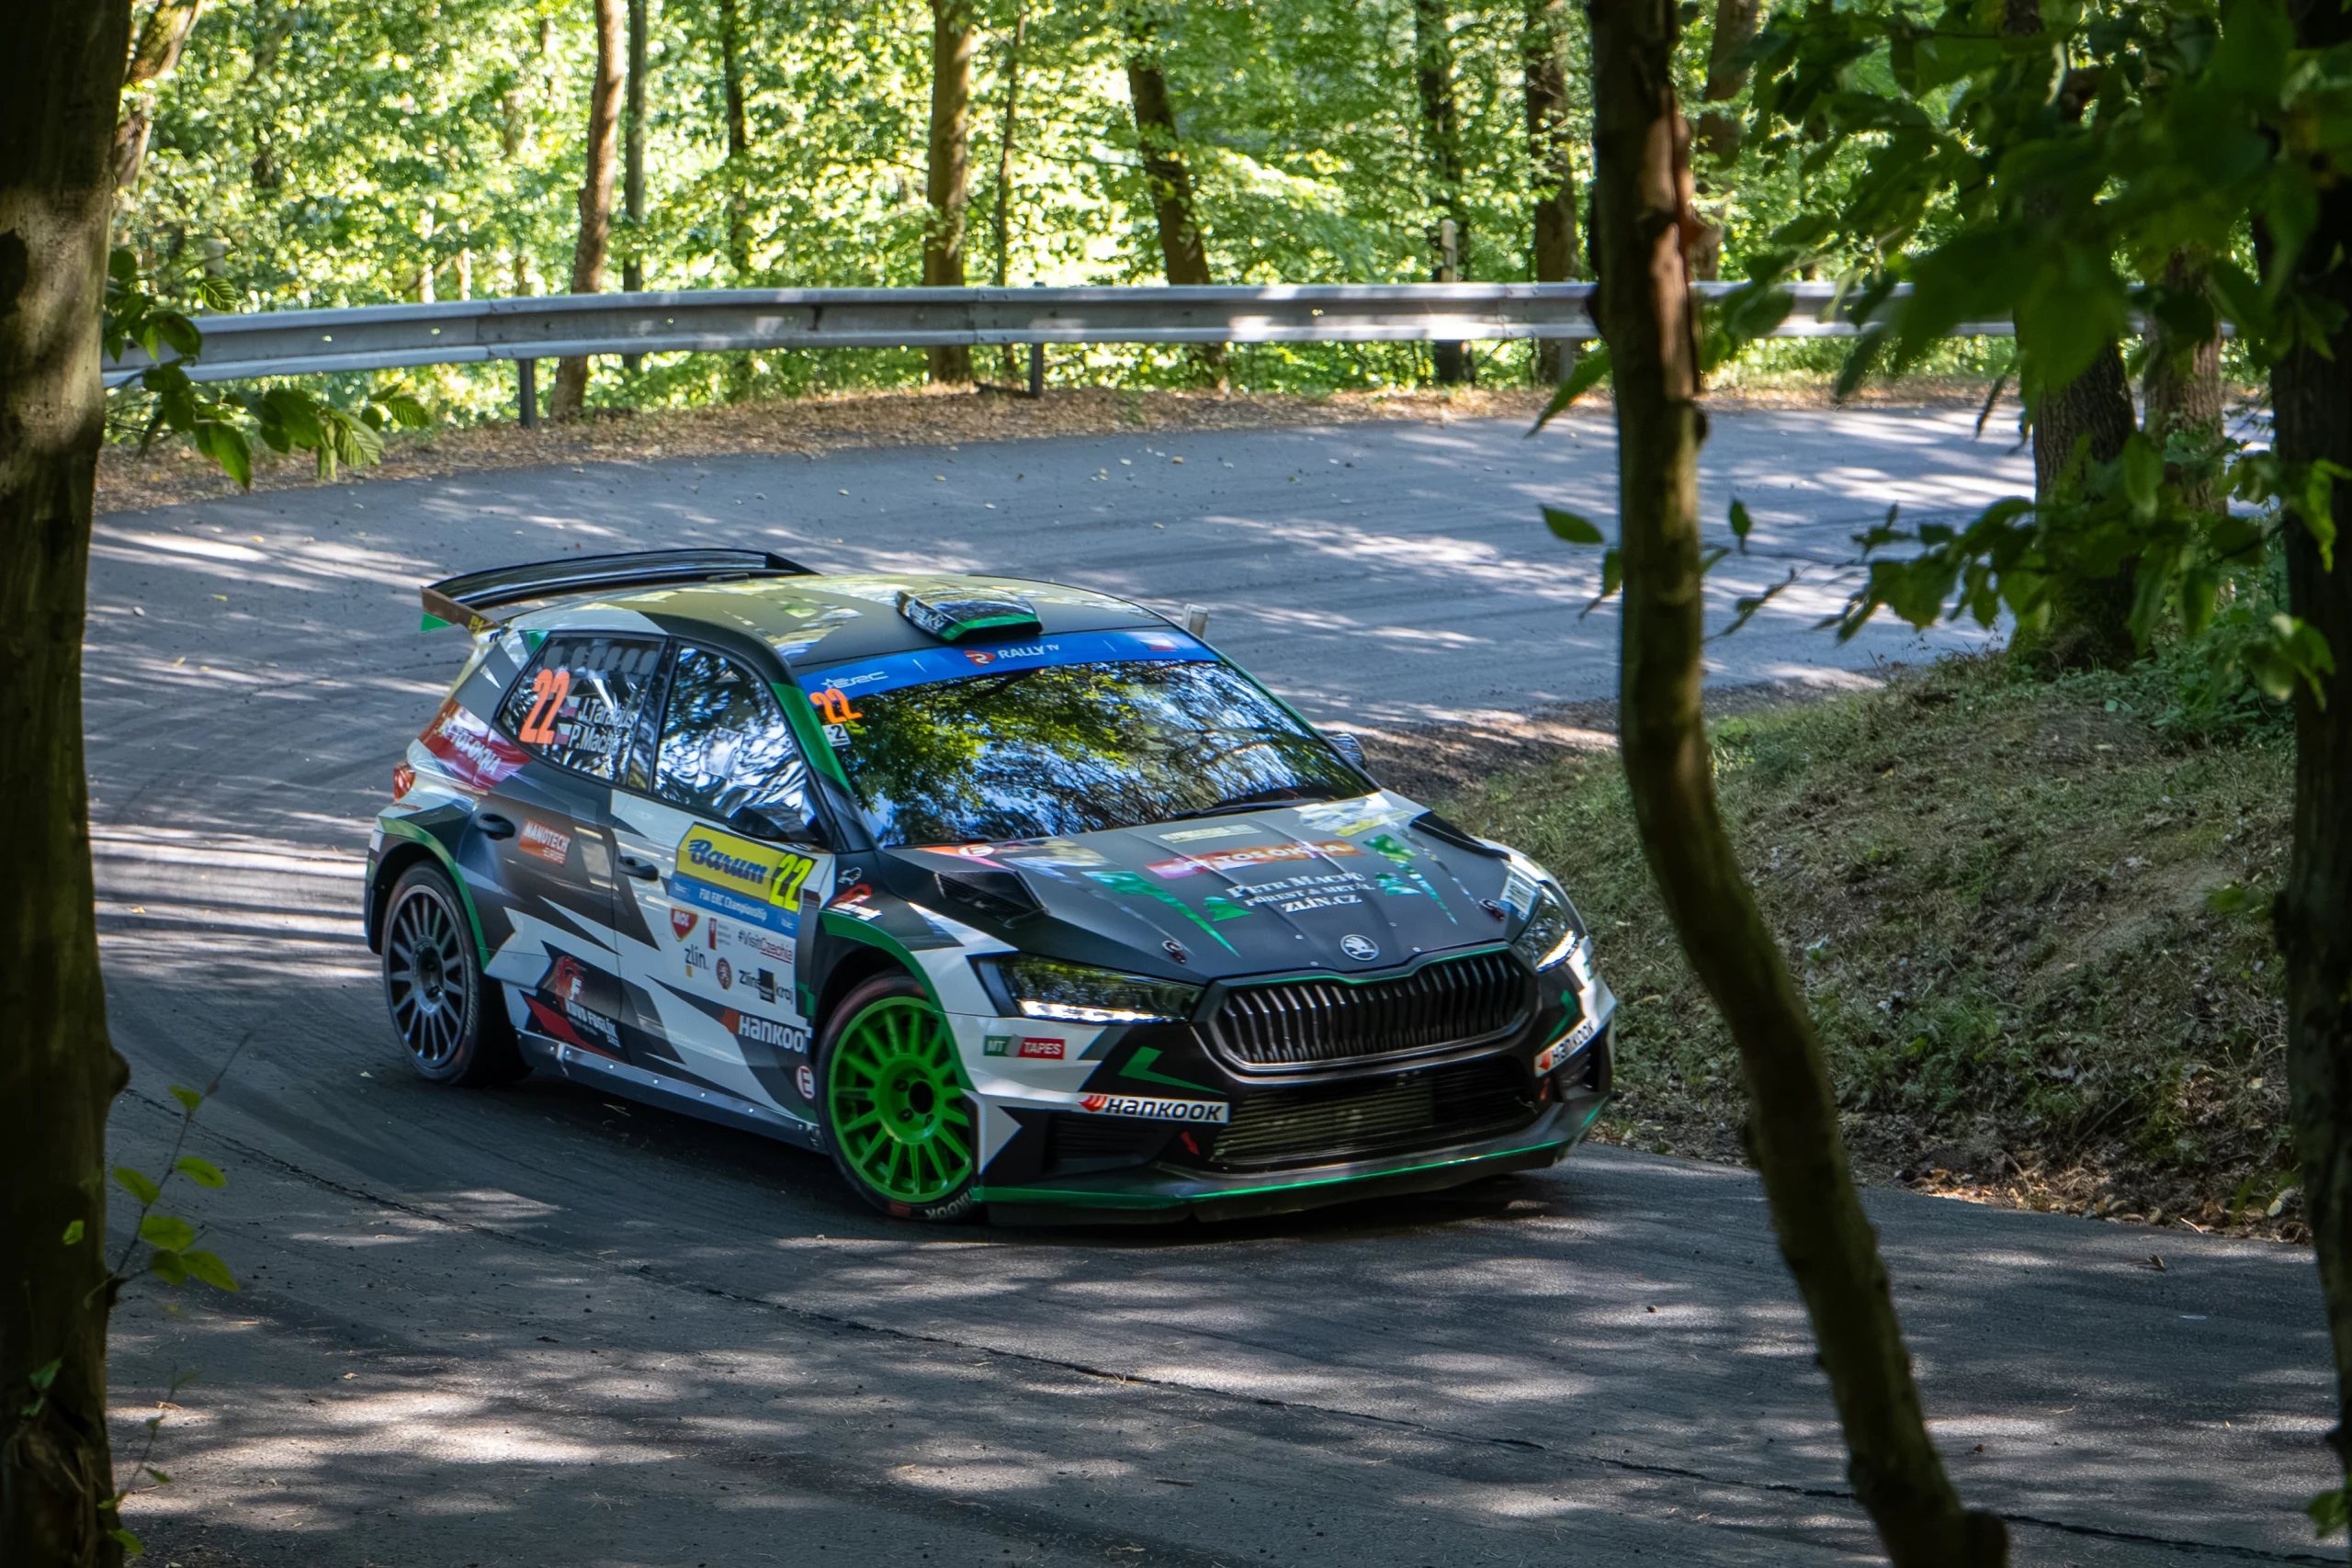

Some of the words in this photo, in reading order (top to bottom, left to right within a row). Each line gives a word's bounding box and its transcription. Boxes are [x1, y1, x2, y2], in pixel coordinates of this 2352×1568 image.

[998, 646, 1046, 659] RALLY
[519, 669, 570, 745] 22
[809, 688, 863, 724] 22
[688, 839, 768, 885] Barum
[769, 853, 813, 912] 22
[1226, 882, 1291, 898] PETR
[987, 1040, 1006, 1052] MT
[1023, 1042, 1062, 1055] TAPES
